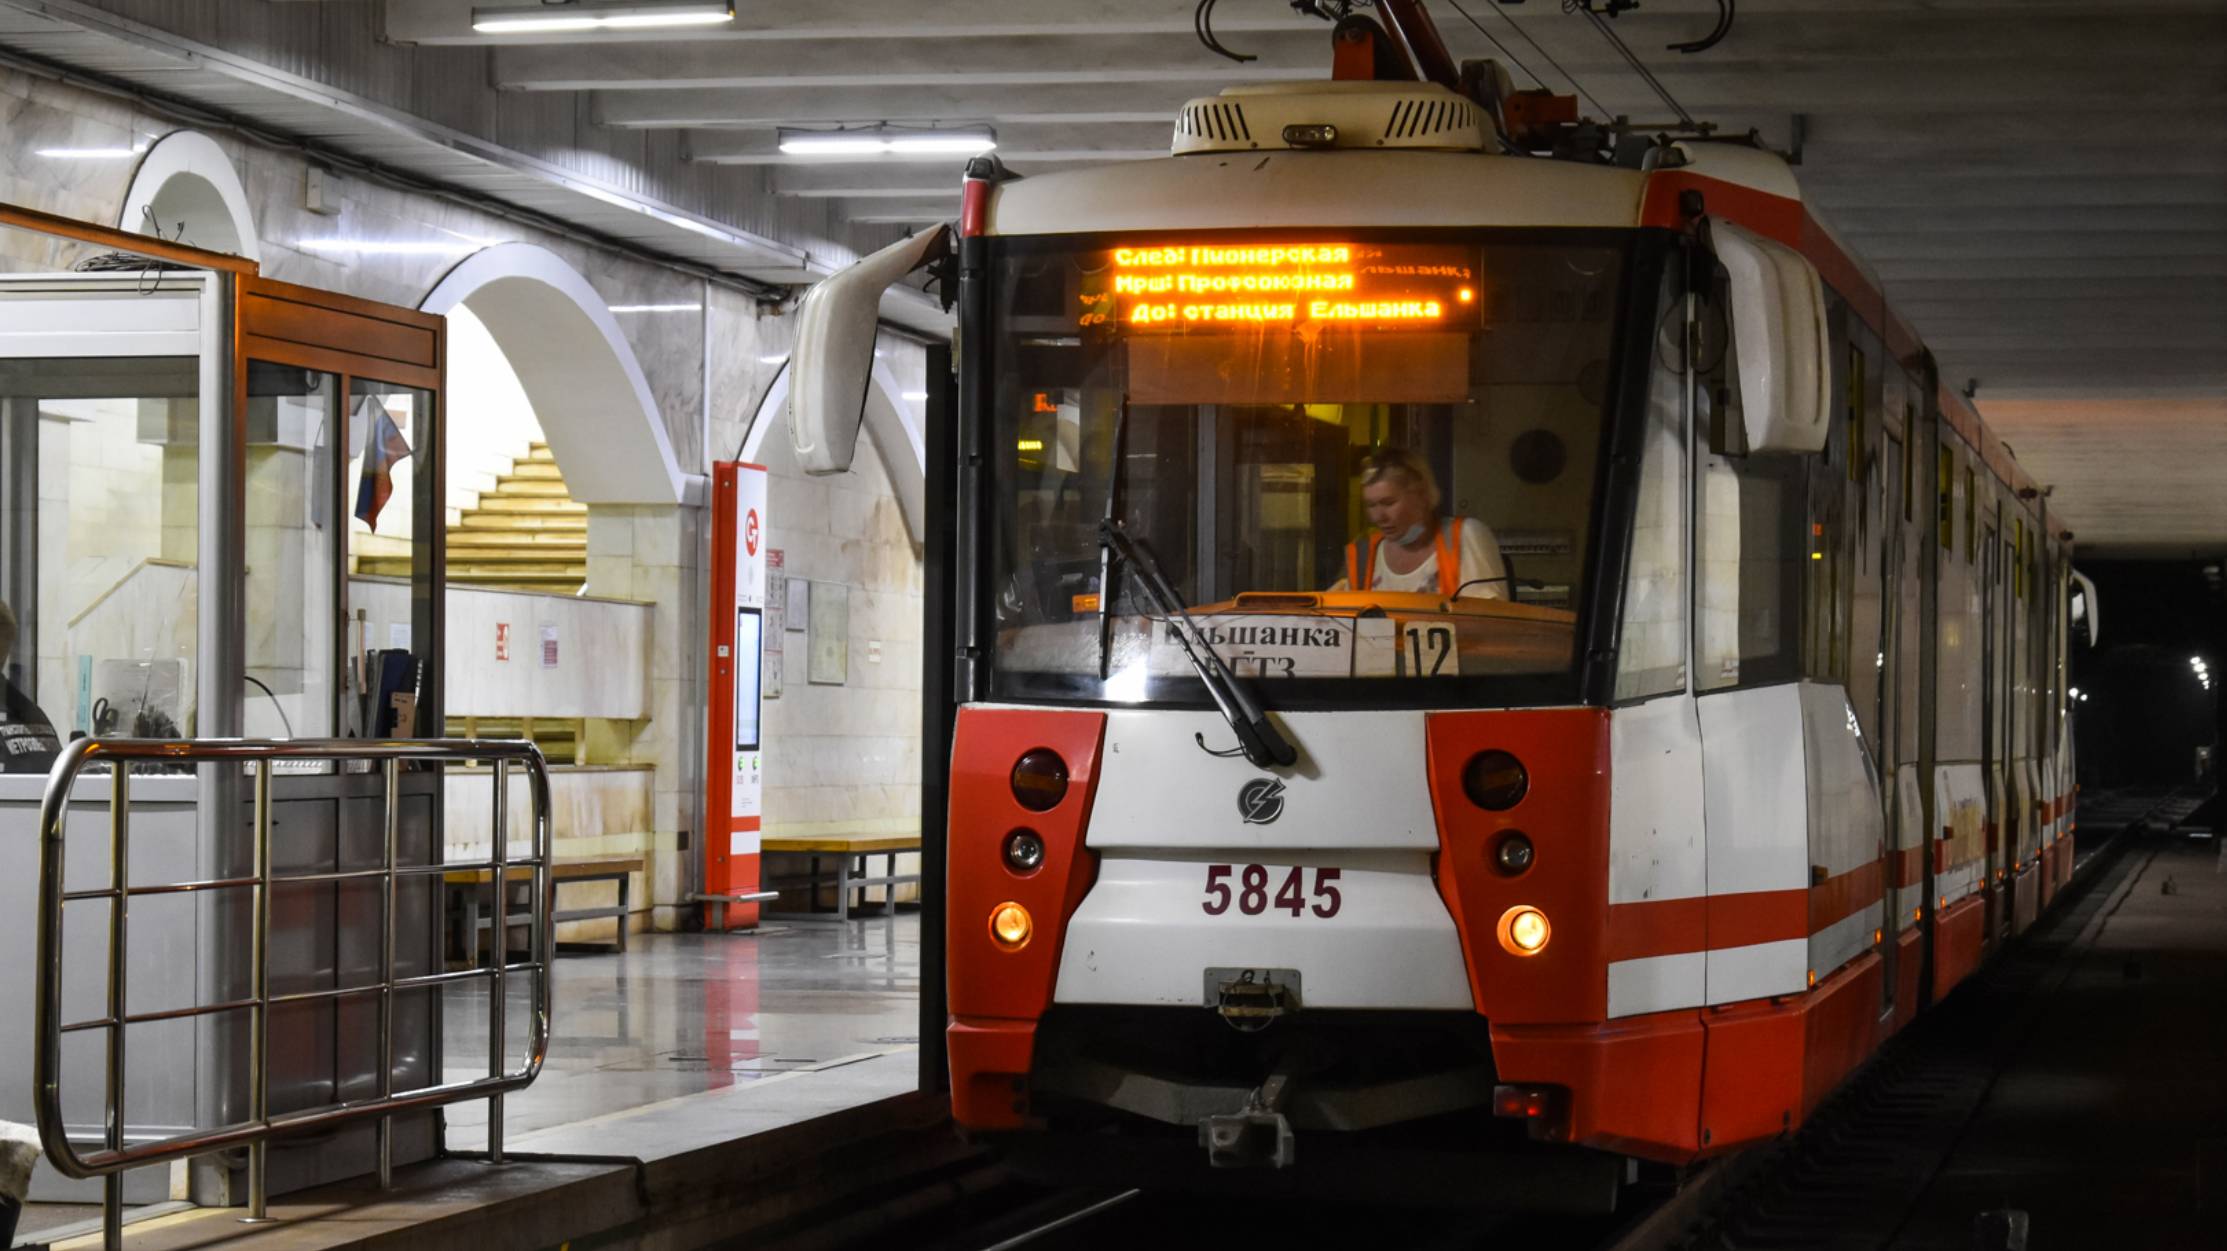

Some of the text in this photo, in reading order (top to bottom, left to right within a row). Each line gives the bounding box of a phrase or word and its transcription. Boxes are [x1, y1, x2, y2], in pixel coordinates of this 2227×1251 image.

[1114, 246, 1186, 267] След:
[1190, 245, 1350, 267] Пионерская
[1177, 272, 1355, 295] Профсоюзная
[1130, 300, 1441, 324] До: станция Ельшанка
[1405, 626, 1452, 678] 12
[1201, 863, 1342, 919] 5845
